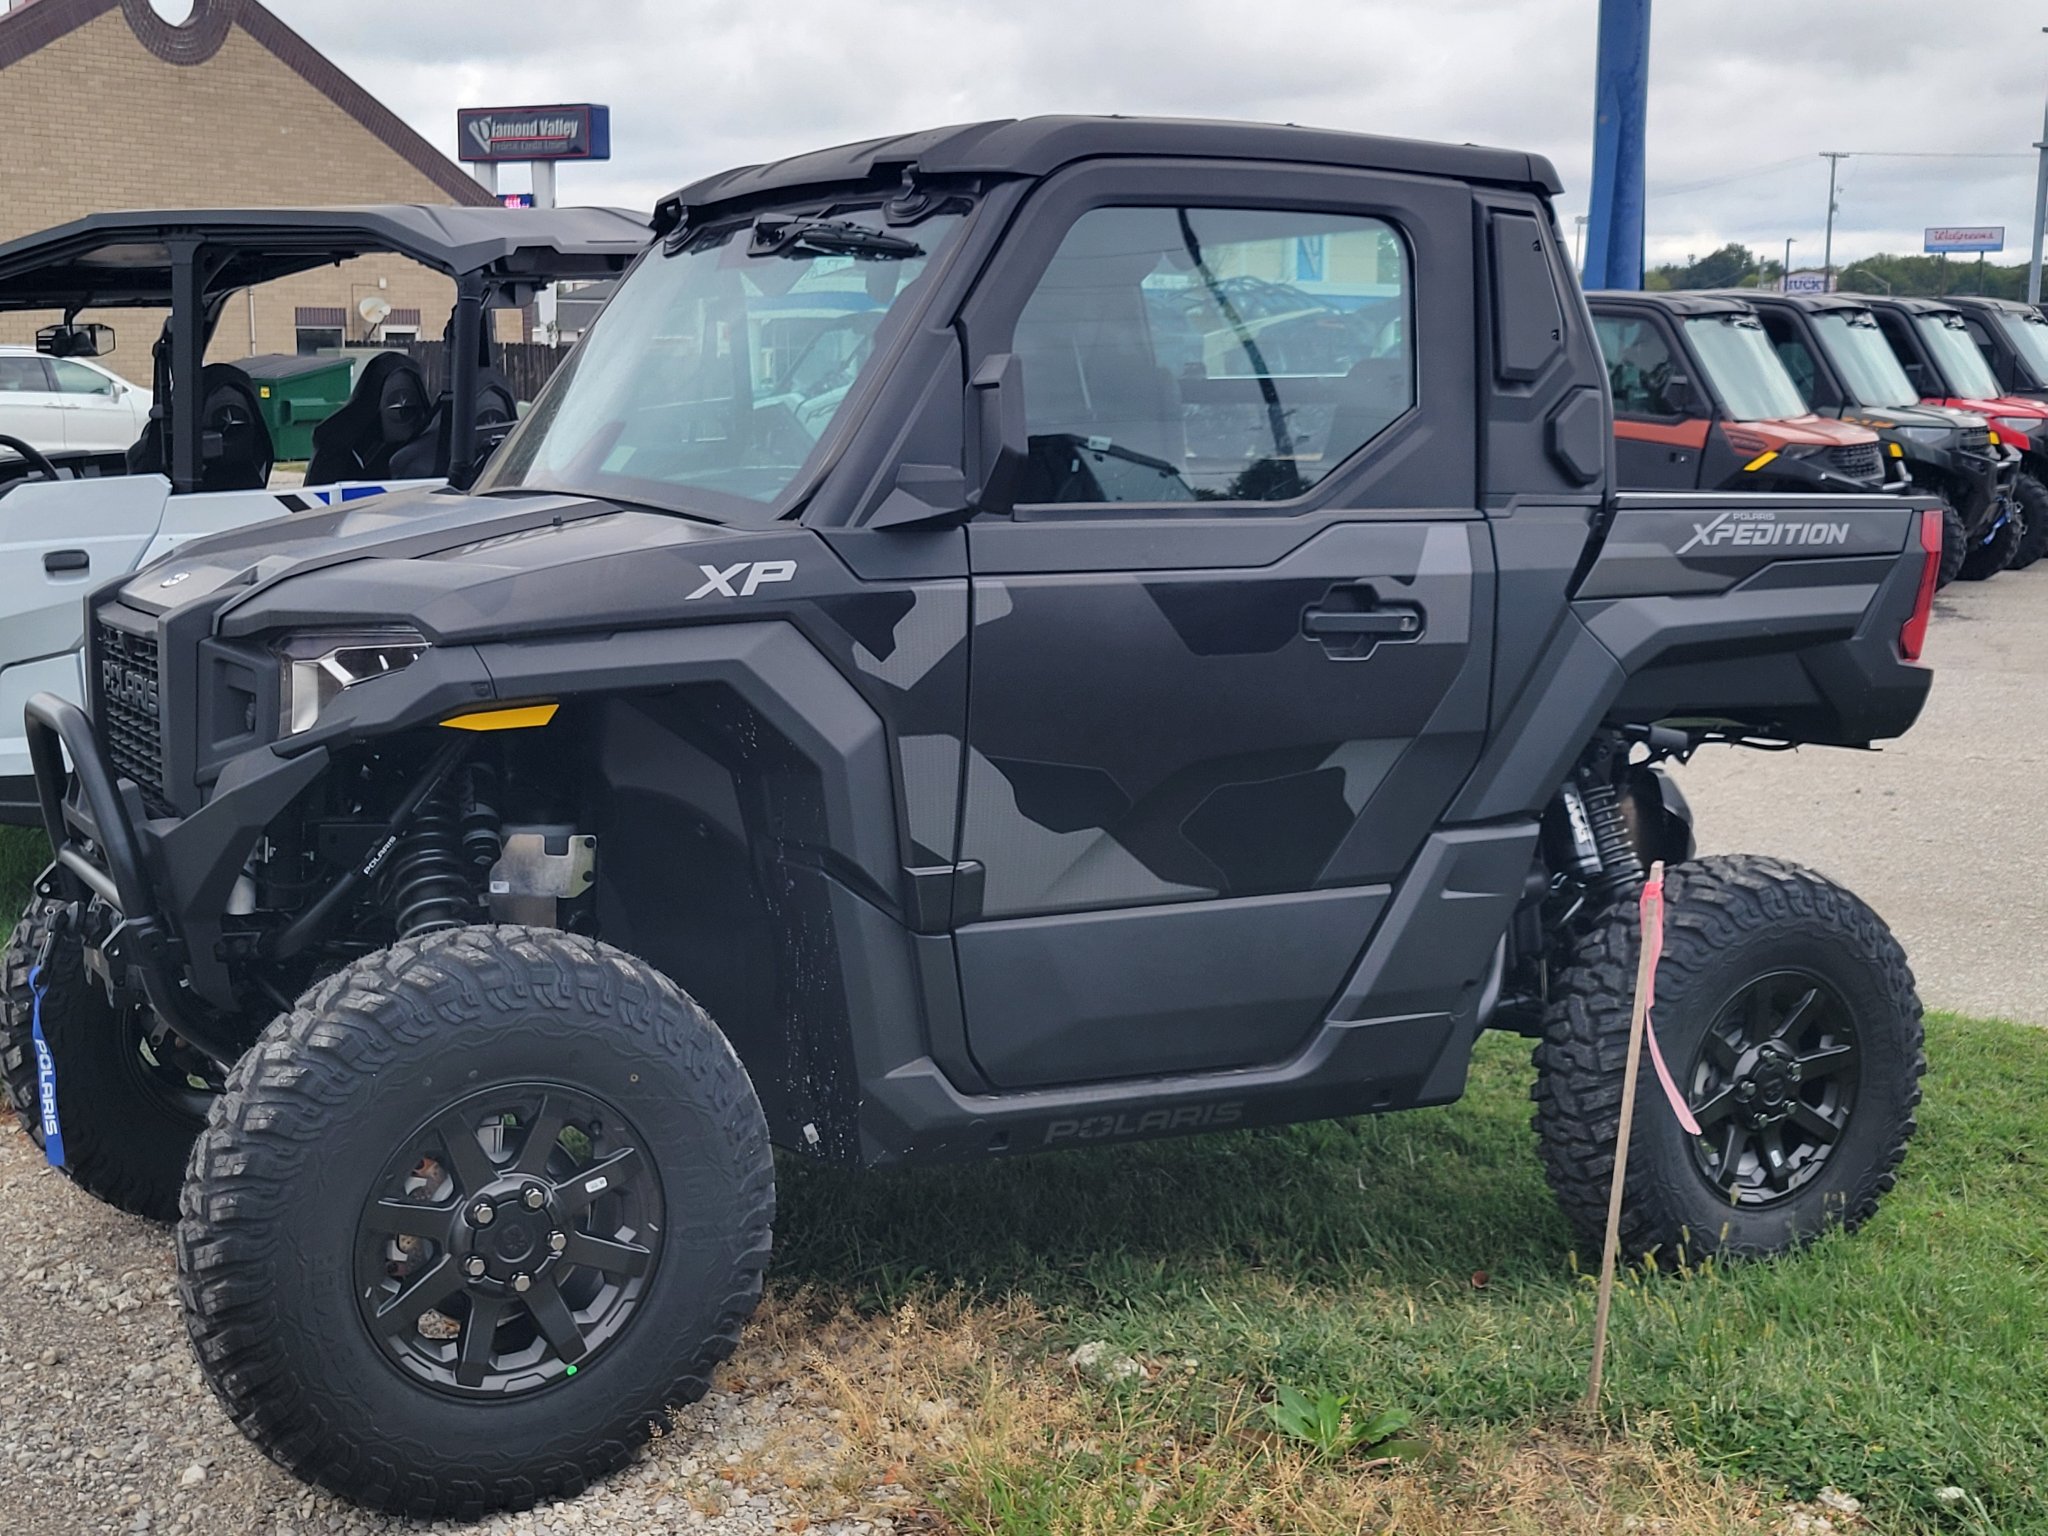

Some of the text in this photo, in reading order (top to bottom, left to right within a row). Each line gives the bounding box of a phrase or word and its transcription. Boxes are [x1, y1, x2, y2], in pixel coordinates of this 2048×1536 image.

[540, 118, 579, 139] Valley
[1934, 229, 1994, 244] Walgreens
[1675, 512, 1850, 554] XPEDITION
[1733, 512, 1775, 521] POLARIS
[684, 560, 798, 600] XP
[102, 659, 158, 716] POLARIS
[363, 835, 397, 875] POLARIS
[35, 1039, 58, 1136] POLARIS
[1044, 1102, 1244, 1145] POLARIS
